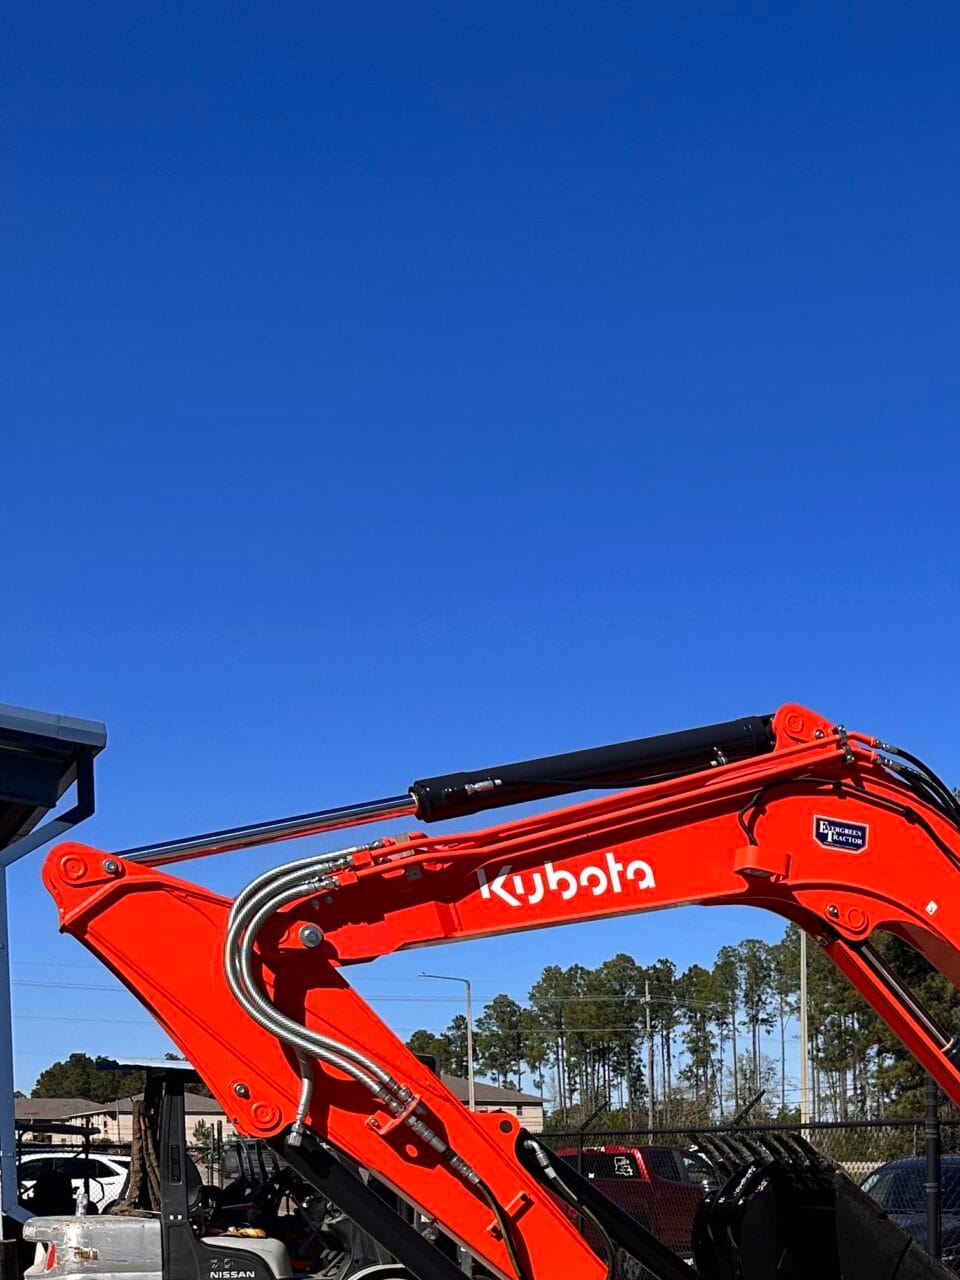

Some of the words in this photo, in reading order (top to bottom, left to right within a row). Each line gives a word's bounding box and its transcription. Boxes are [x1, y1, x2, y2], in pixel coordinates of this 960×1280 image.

[819, 820, 862, 836] EVERGREEN
[827, 831, 863, 845] TRACTOR
[476, 852, 656, 907] Kubota
[210, 1271, 255, 1279] NISSAN
